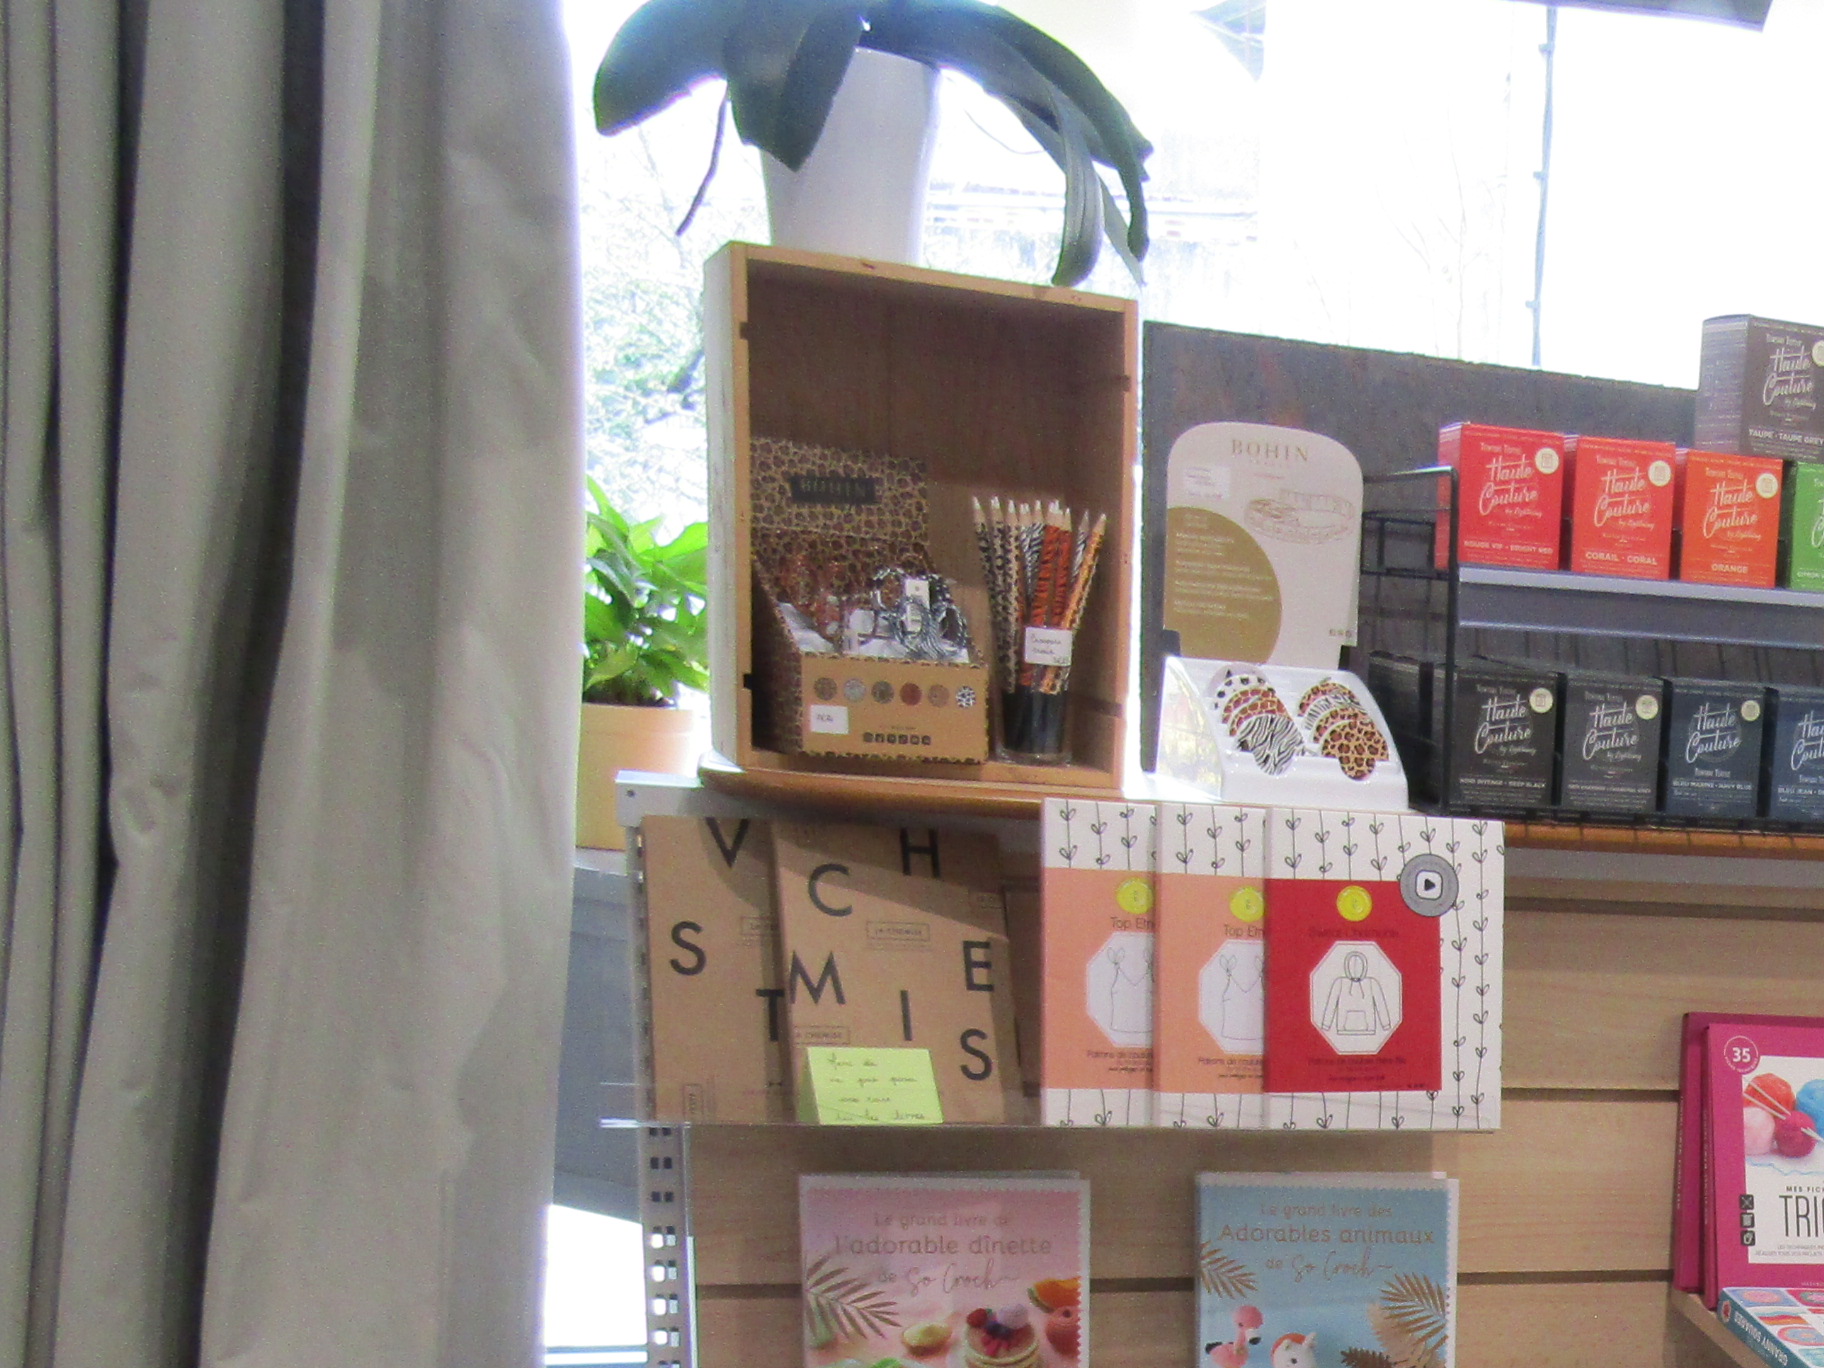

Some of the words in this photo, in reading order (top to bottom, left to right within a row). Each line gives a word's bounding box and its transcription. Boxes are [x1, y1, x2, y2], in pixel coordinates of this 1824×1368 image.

[1770, 346, 1812, 373] Haute
[1763, 372, 1815, 405] Couture
[1231, 439, 1309, 461] BOHIN
[1486, 453, 1534, 481] Haute
[1601, 467, 1646, 494] Haute
[1479, 482, 1538, 516] Couture
[1710, 479, 1755, 507] Haute
[1593, 494, 1650, 528] Couture
[1703, 506, 1759, 539] Couture
[1585, 551, 1619, 562] CORAIL
[1626, 555, 1658, 565] CORAL
[1711, 563, 1748, 574] ORANGE
[1481, 693, 1529, 722] Haute
[1589, 702, 1634, 728] Haute
[1693, 702, 1738, 731] Haute
[1474, 721, 1532, 754] Couture
[1583, 728, 1639, 761] Couture
[1685, 730, 1741, 764] Couture
[901, 828, 940, 877] H
[808, 863, 852, 916] C
[1111, 916, 1131, 930] Top
[1224, 924, 1244, 937] Top
[669, 921, 707, 976] S
[789, 950, 846, 1005] M
[962, 940, 994, 992] E
[960, 1028, 993, 1081] S
[1732, 1046, 1751, 1063] 35
[1220, 1223, 1331, 1242] Adorables
[1341, 1227, 1433, 1244] animaux
